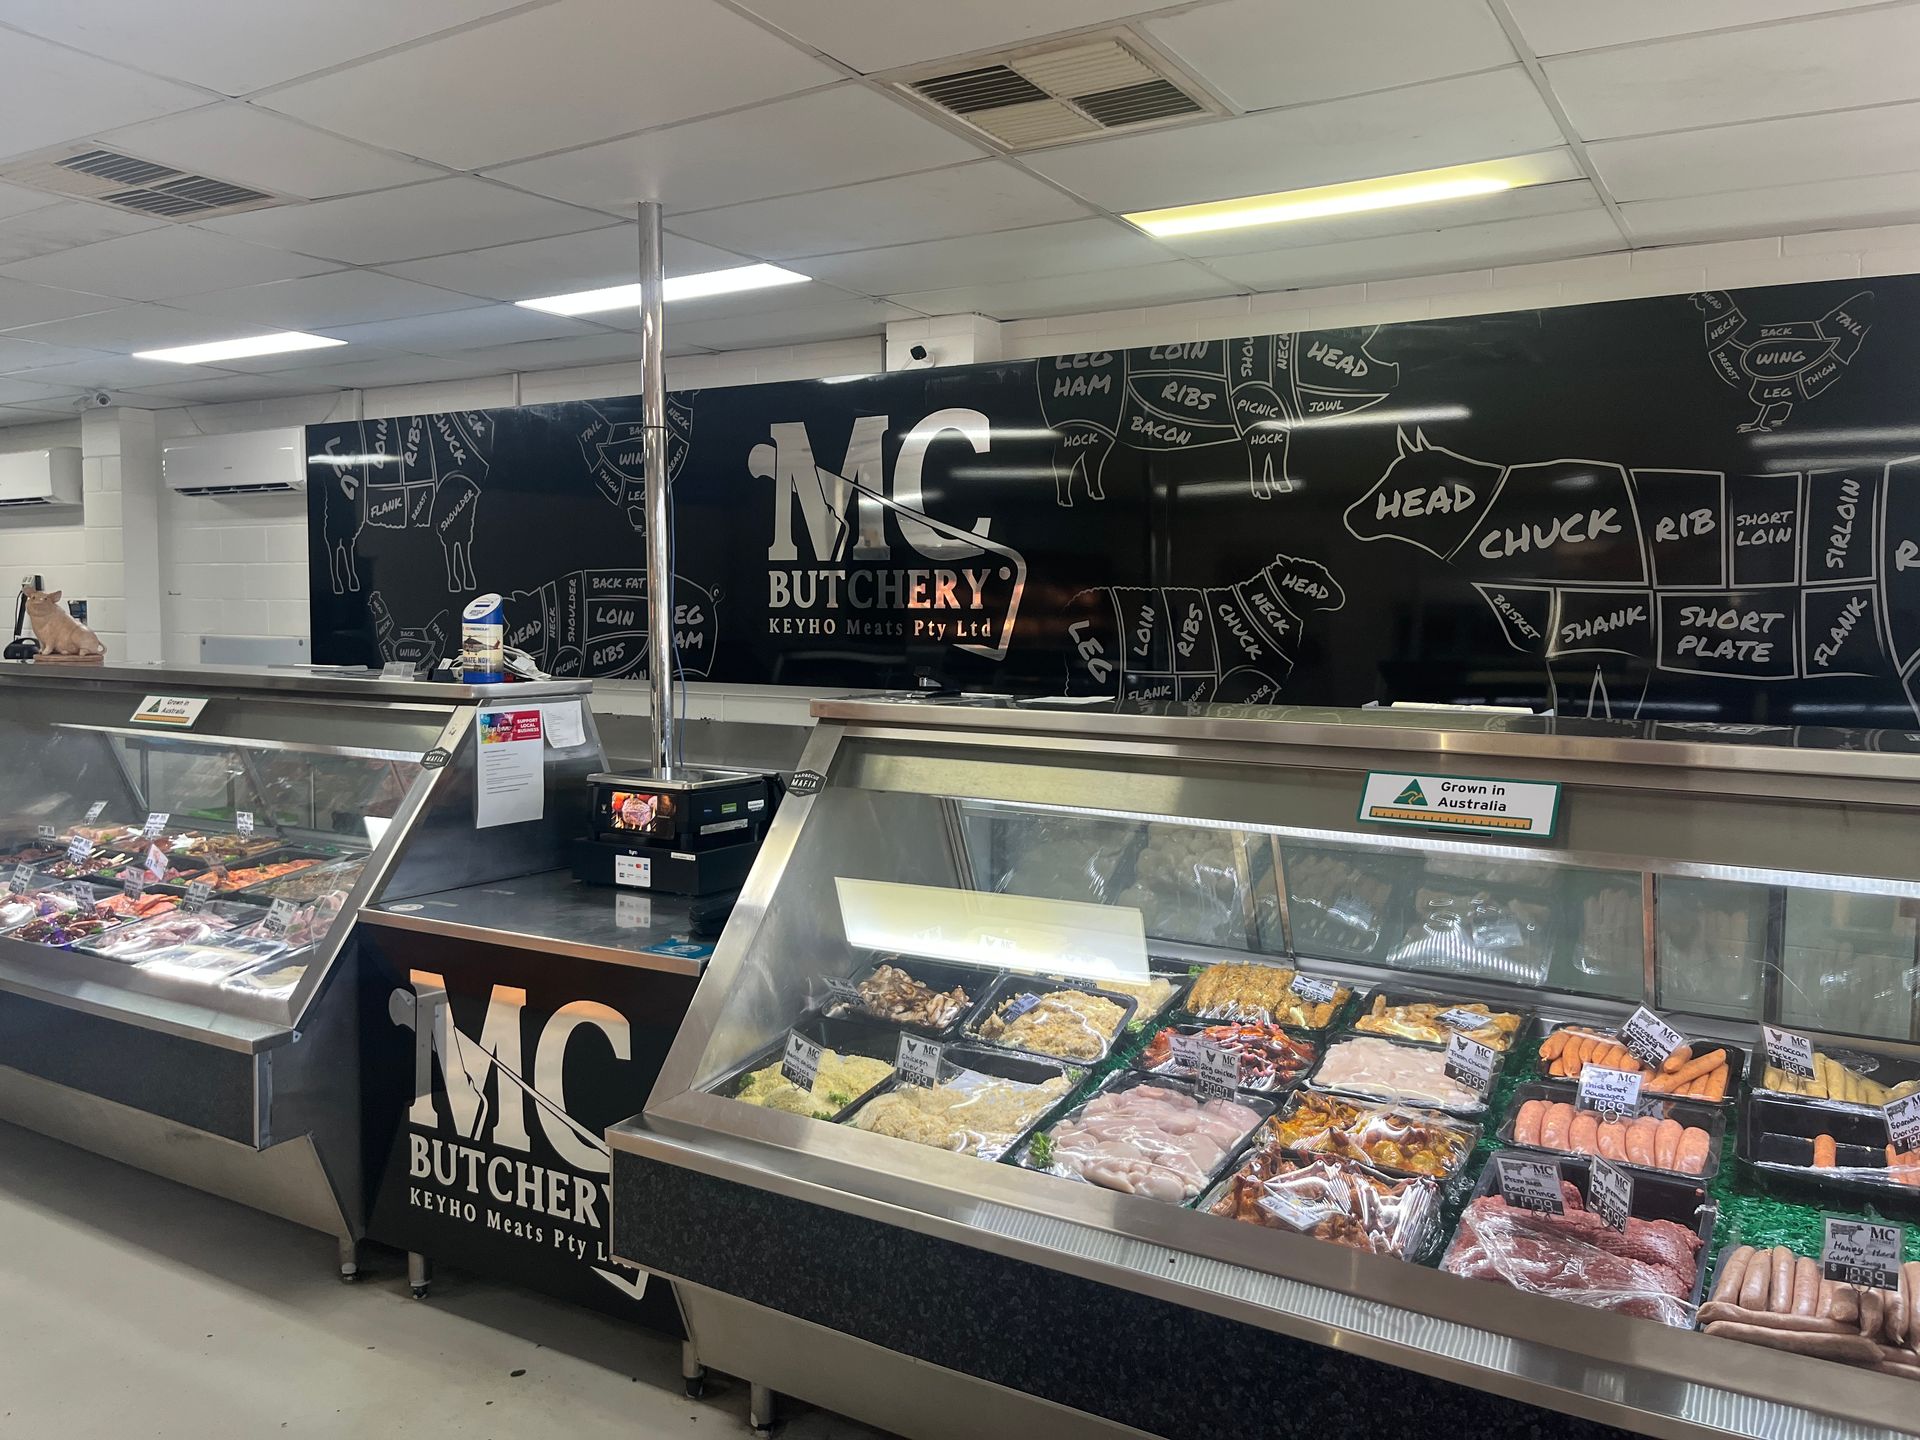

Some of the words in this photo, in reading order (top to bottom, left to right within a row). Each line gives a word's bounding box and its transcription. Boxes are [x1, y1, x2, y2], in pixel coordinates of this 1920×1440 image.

[1701, 292, 1722, 310] HEAD
[1710, 315, 1739, 340] NECK
[1760, 327, 1793, 337] BACK
[1834, 311, 1863, 336] TAIL
[1306, 341, 1369, 378] HEAD
[1716, 351, 1742, 382] BREAST
[1756, 350, 1807, 366] WING
[1052, 374, 1112, 398] HAM
[1803, 362, 1837, 387] THIGH
[1160, 380, 1217, 410] RIBS
[1763, 387, 1793, 399] LEG
[1236, 399, 1279, 418] PICNIC
[1308, 400, 1344, 413] JOWL
[580, 419, 603, 443] TAIL
[667, 407, 690, 431] NECK
[1130, 415, 1192, 446] BACON
[404, 416, 423, 467] RIBS
[1062, 432, 1099, 447] HOCK
[1250, 433, 1284, 445] HOCK
[618, 452, 645, 466] WIN
[599, 468, 620, 494] THIGH
[767, 407, 991, 562] MC
[370, 497, 403, 519] FLANK
[411, 491, 428, 521] BREAST
[440, 489, 475, 531] SHOULDER
[1375, 484, 1476, 521] HEAD
[1655, 508, 1716, 543] RIB
[1736, 510, 1794, 526] SHORT
[1825, 478, 1861, 569] SIRLOIN
[1479, 507, 1622, 559] CHUCK
[1736, 527, 1793, 547] LOIN
[592, 577, 623, 589] BACK
[625, 577, 647, 589] FAT
[768, 568, 992, 609] BUTCHERY
[1281, 573, 1330, 600] HEAD
[548, 606, 557, 639] NECK
[567, 578, 577, 643] SHOULDER
[596, 606, 635, 626] LOIN
[673, 604, 705, 625] EG
[1251, 592, 1290, 636] NECK
[1491, 594, 1542, 641] BRISKET
[1680, 605, 1785, 635] SHORT
[432, 622, 446, 641] TAIL
[509, 620, 542, 647] HEAD
[768, 617, 836, 635] KEYHO
[846, 618, 904, 636] Meats
[913, 619, 947, 641] Pty
[956, 617, 992, 638] Ltd
[1133, 605, 1155, 657] LOIN
[1177, 602, 1203, 658] RIBS
[1218, 603, 1263, 661] CHUCK
[1561, 605, 1647, 644] SHANK
[1813, 596, 1868, 668] FLANK
[672, 631, 704, 649] AM
[1067, 619, 1113, 685] LEG
[1677, 636, 1775, 663] PLATE
[399, 648, 422, 657] WING
[592, 642, 626, 666] RIBS
[555, 657, 579, 676] PICNIC
[1127, 685, 1172, 702] FLANK
[791, 778, 817, 788] MAFIA
[1440, 781, 1487, 796] Grown
[1492, 784, 1506, 796] in
[1437, 796, 1507, 812] Australia
[1660, 1027, 1679, 1043] MC
[1791, 1035, 1808, 1047] MC
[806, 1046, 820, 1059] MC
[923, 1045, 938, 1056] MC
[1222, 1054, 1236, 1066] MC
[1475, 1045, 1491, 1059] MC
[409, 968, 632, 1174] MC
[1617, 1073, 1637, 1084] MC
[1594, 1099, 1625, 1115] 1899
[409, 1132, 611, 1229] BUTCHER
[1532, 1164, 1554, 1176] MC
[1614, 1173, 1628, 1192] MC
[410, 1186, 477, 1222] KEYHO
[486, 1208, 543, 1243] Meats
[554, 1229, 587, 1261] Pty
[1869, 1226, 1896, 1242] MC
[1845, 1267, 1886, 1288] 1899
